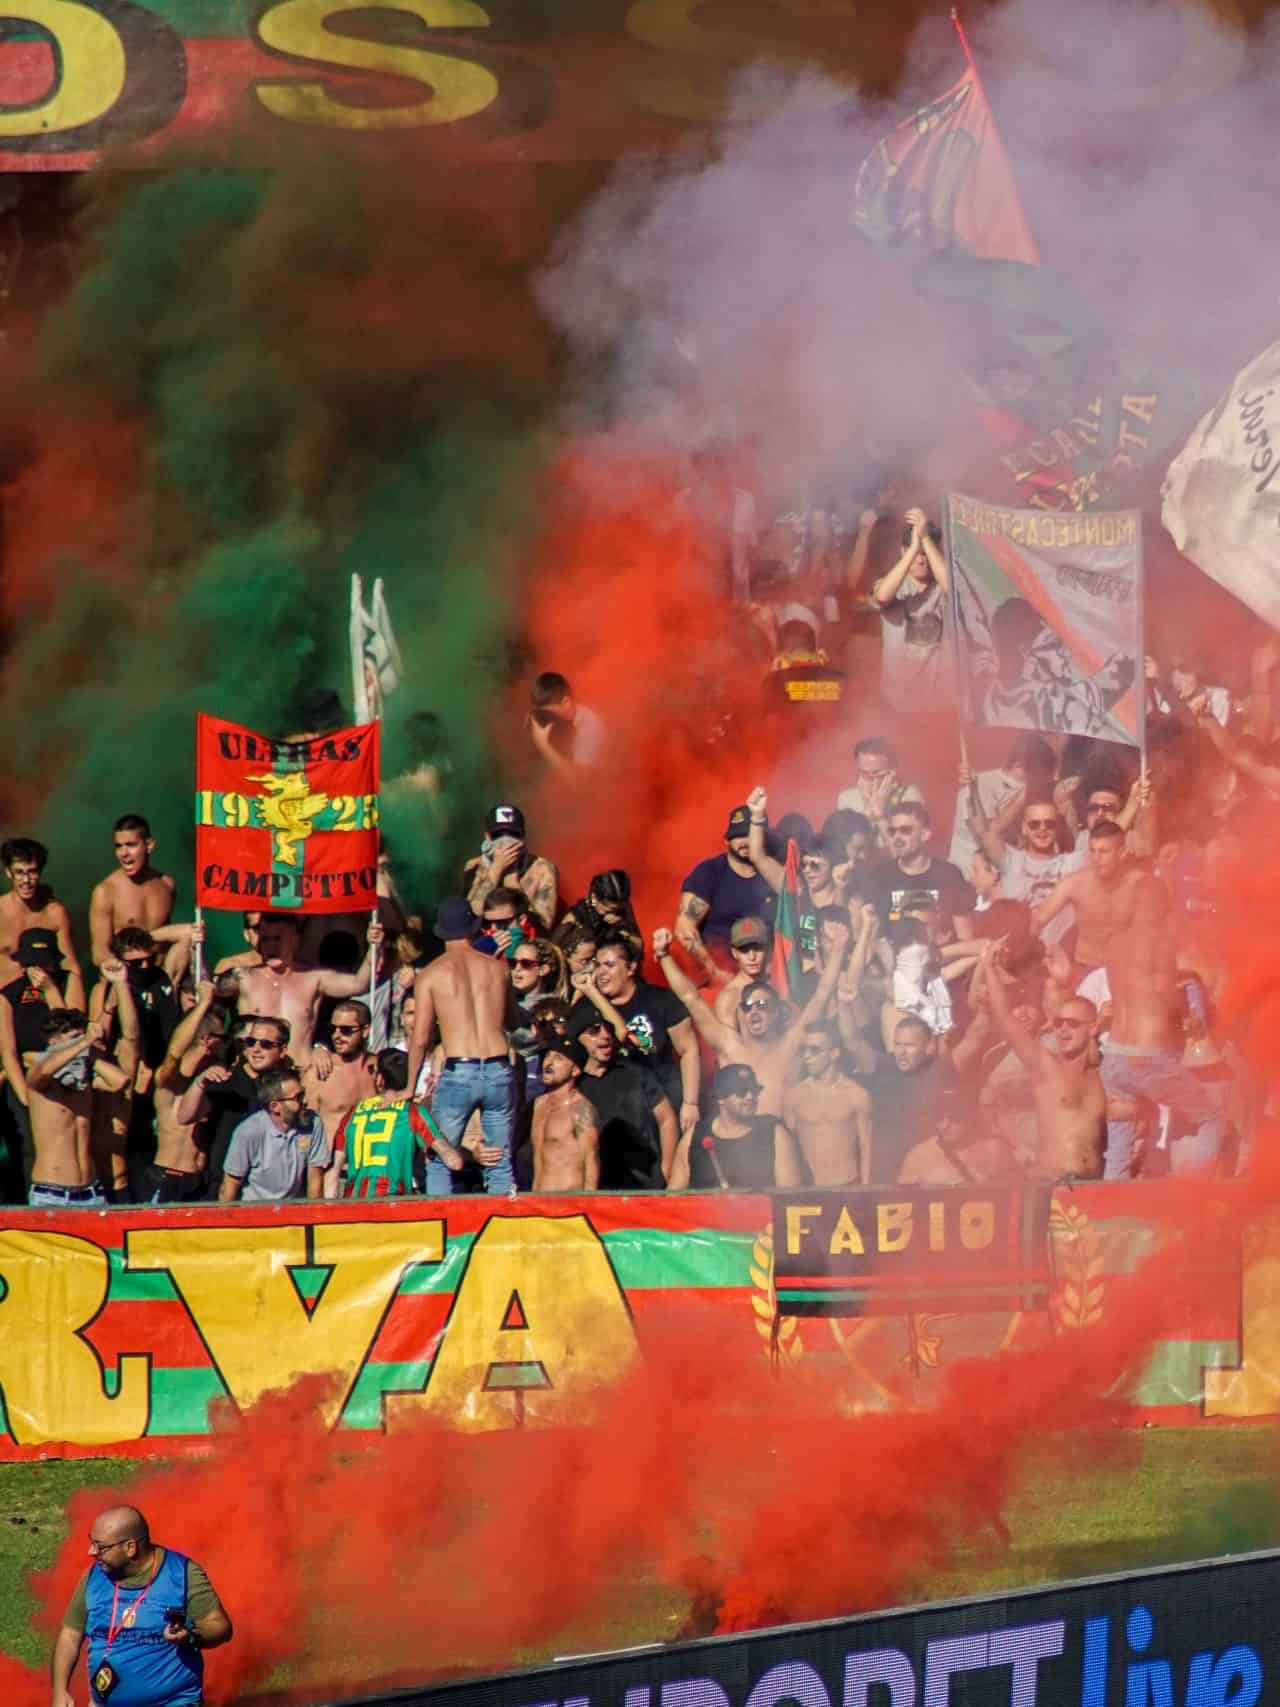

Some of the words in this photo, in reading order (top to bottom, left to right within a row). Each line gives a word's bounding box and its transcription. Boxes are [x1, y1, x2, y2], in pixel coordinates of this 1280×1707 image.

[218, 731, 364, 765] ULTRAS
[199, 790, 250, 827] 19
[331, 793, 379, 831] 25
[203, 863, 378, 899] CAMPETTO
[353, 1110, 398, 1170] 12
[785, 1200, 996, 1255] FABIO
